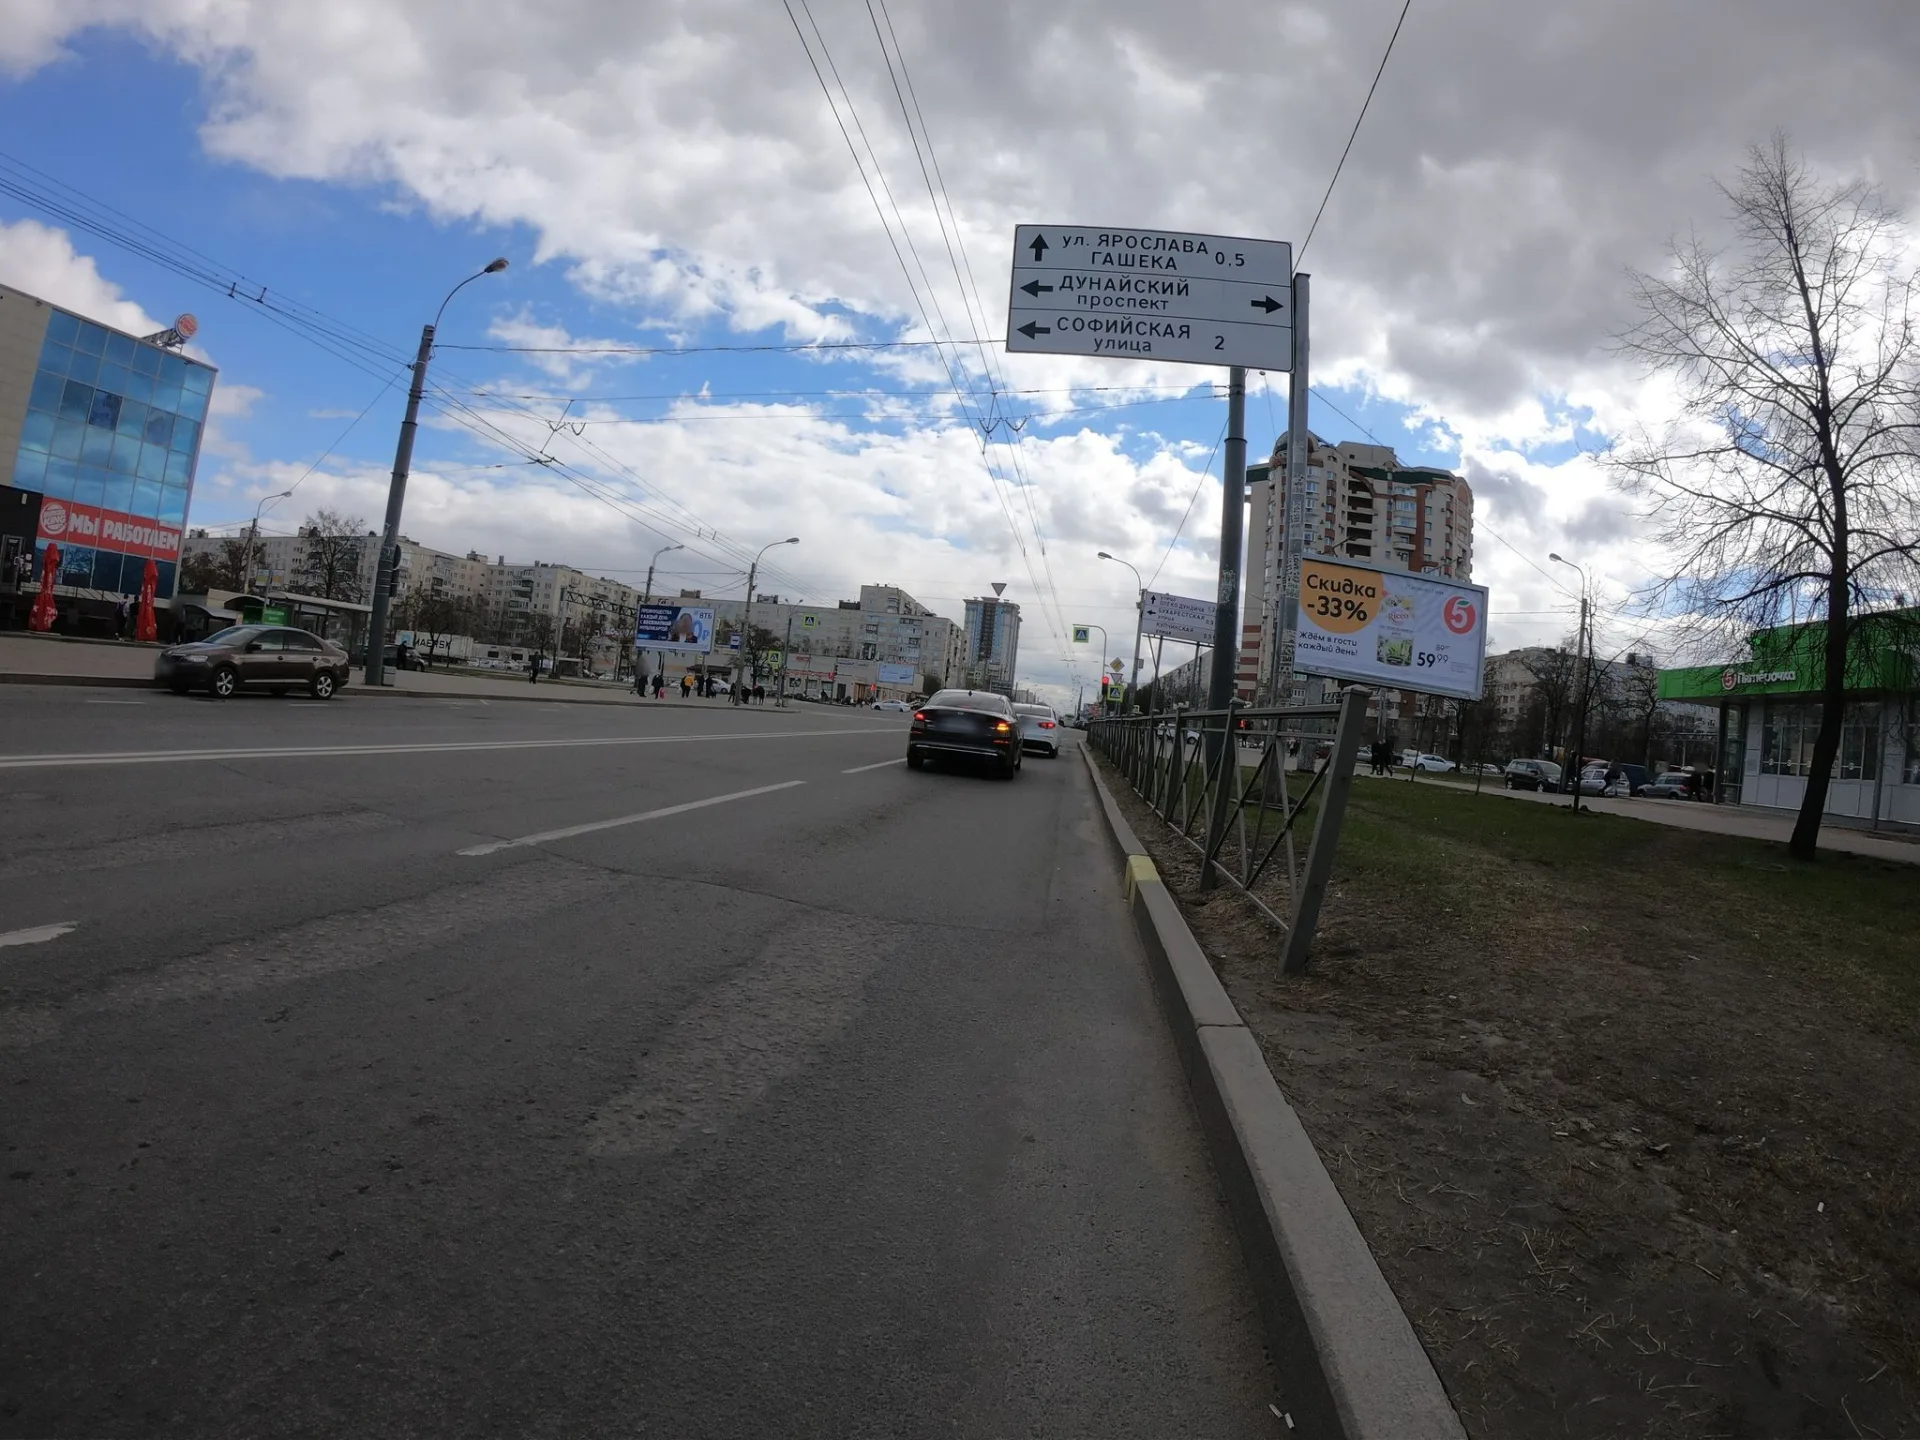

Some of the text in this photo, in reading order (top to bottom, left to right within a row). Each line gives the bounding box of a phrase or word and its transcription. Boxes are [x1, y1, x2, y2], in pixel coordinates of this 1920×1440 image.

[1062, 234, 1208, 255] ул. ЯРОСЛАВА
[1091, 251, 1177, 270] ГАШЕКА
[1215, 252, 1245, 267] 0,5
[1059, 275, 1190, 297] ДУНАЙСКИЙ
[1077, 294, 1169, 311] проспект
[1057, 316, 1191, 340] СОФИЙСКАЯ
[1093, 337, 1152, 353] улица
[1214, 335, 1225, 350] 2
[69, 513, 180, 551] МЫ РАБОТАЕМ
[1306, 574, 1376, 598] Скидка
[1158, 607, 1205, 620] БУХАРЕСТСКАЯ
[1307, 595, 1368, 621] -33%
[1450, 601, 1468, 628] 5
[1299, 630, 1325, 642] Ждём
[1333, 637, 1357, 647] гости
[1298, 642, 1358, 656] каждый день!
